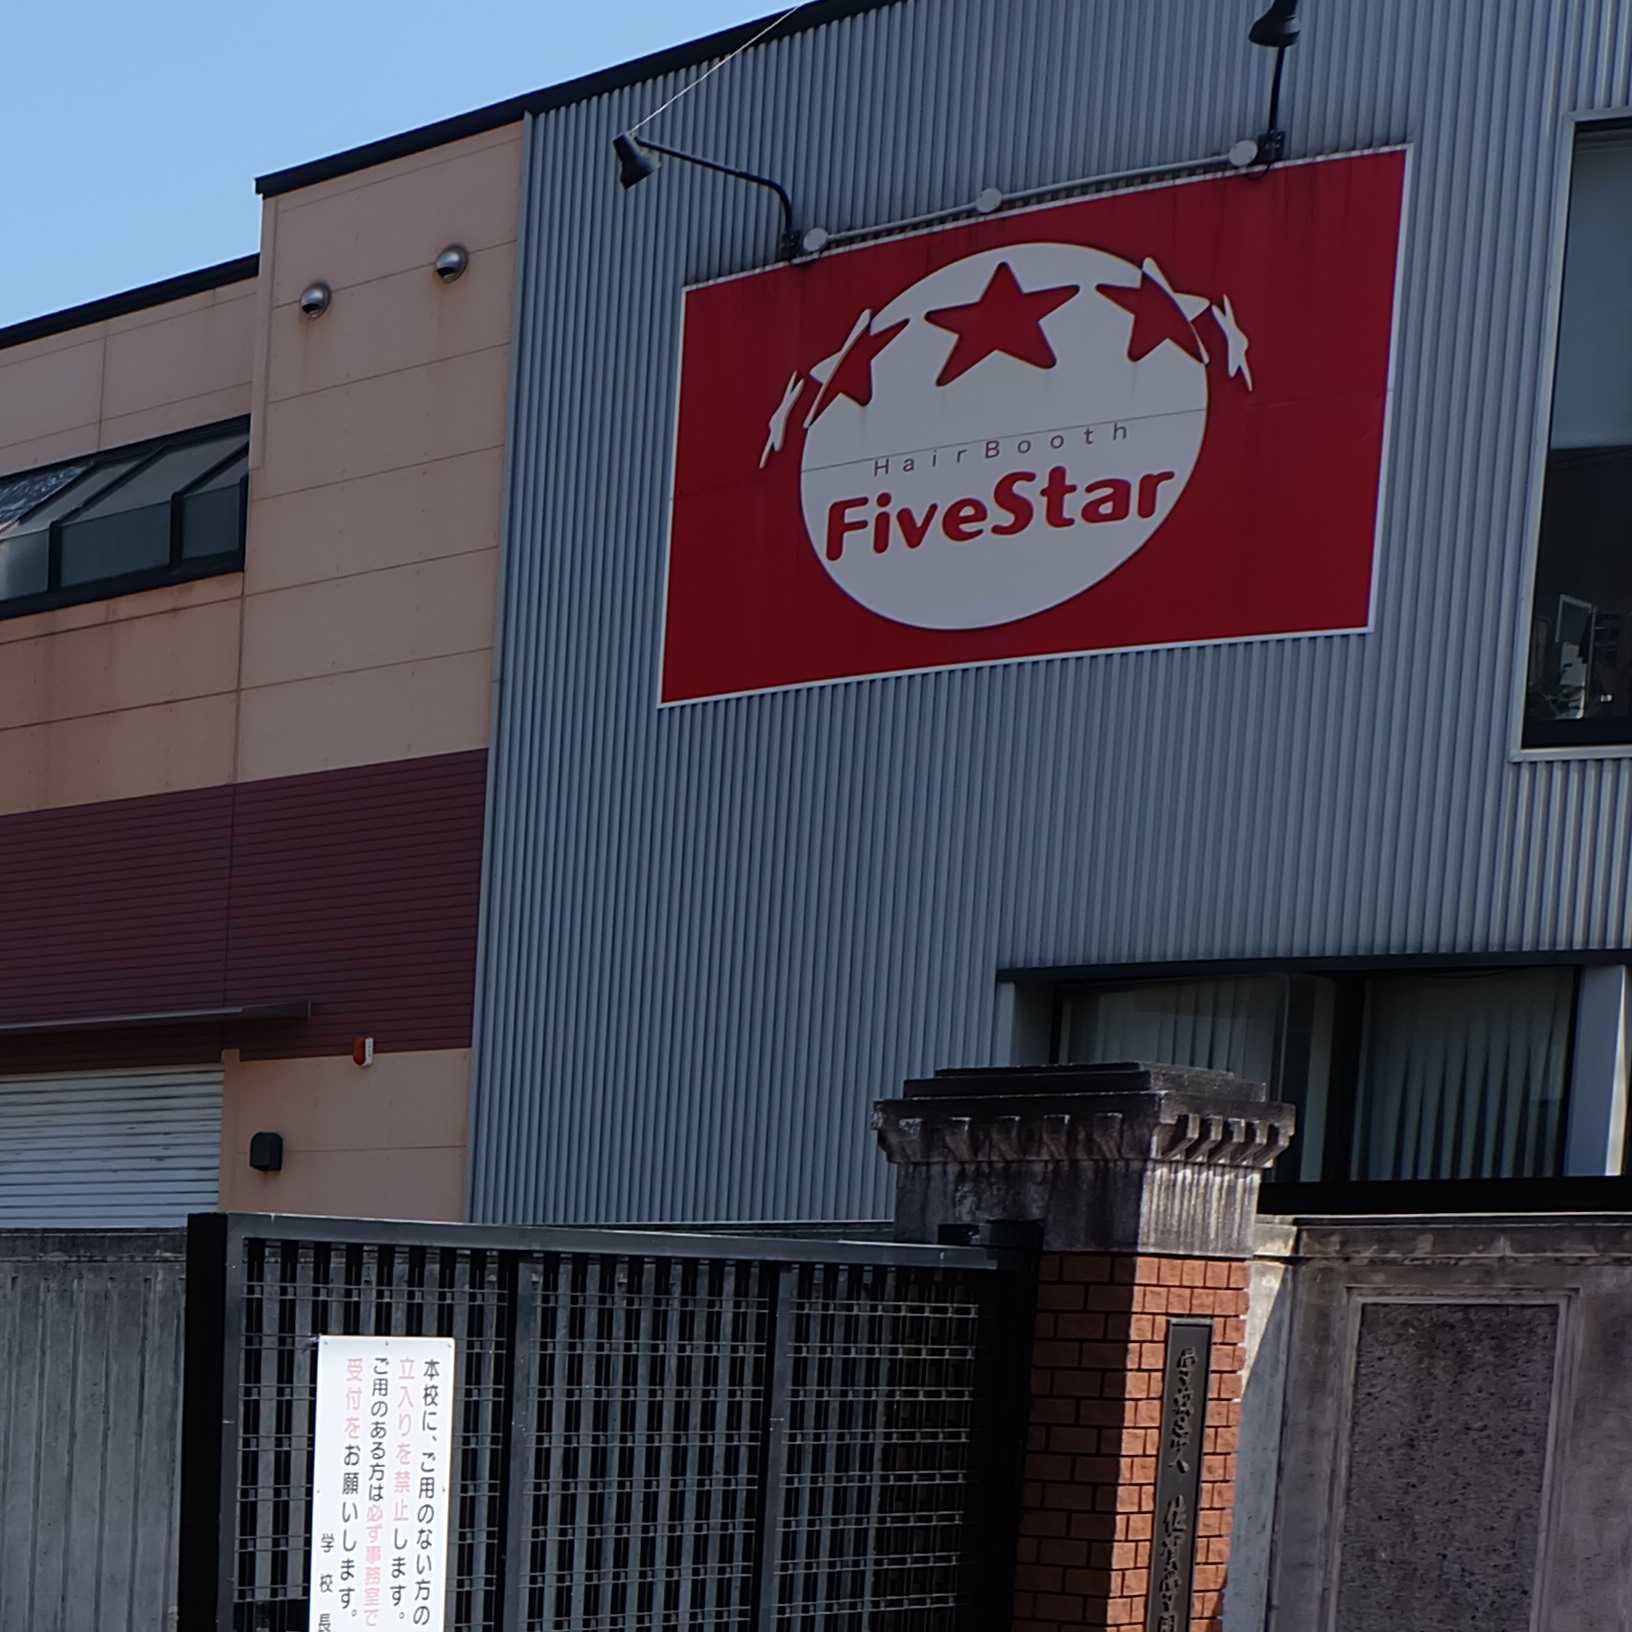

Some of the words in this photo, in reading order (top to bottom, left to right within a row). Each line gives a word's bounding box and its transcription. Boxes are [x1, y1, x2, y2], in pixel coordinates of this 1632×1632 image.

[825, 465, 1176, 562] FiveStar
[318, 1532, 334, 1632] 学校長
